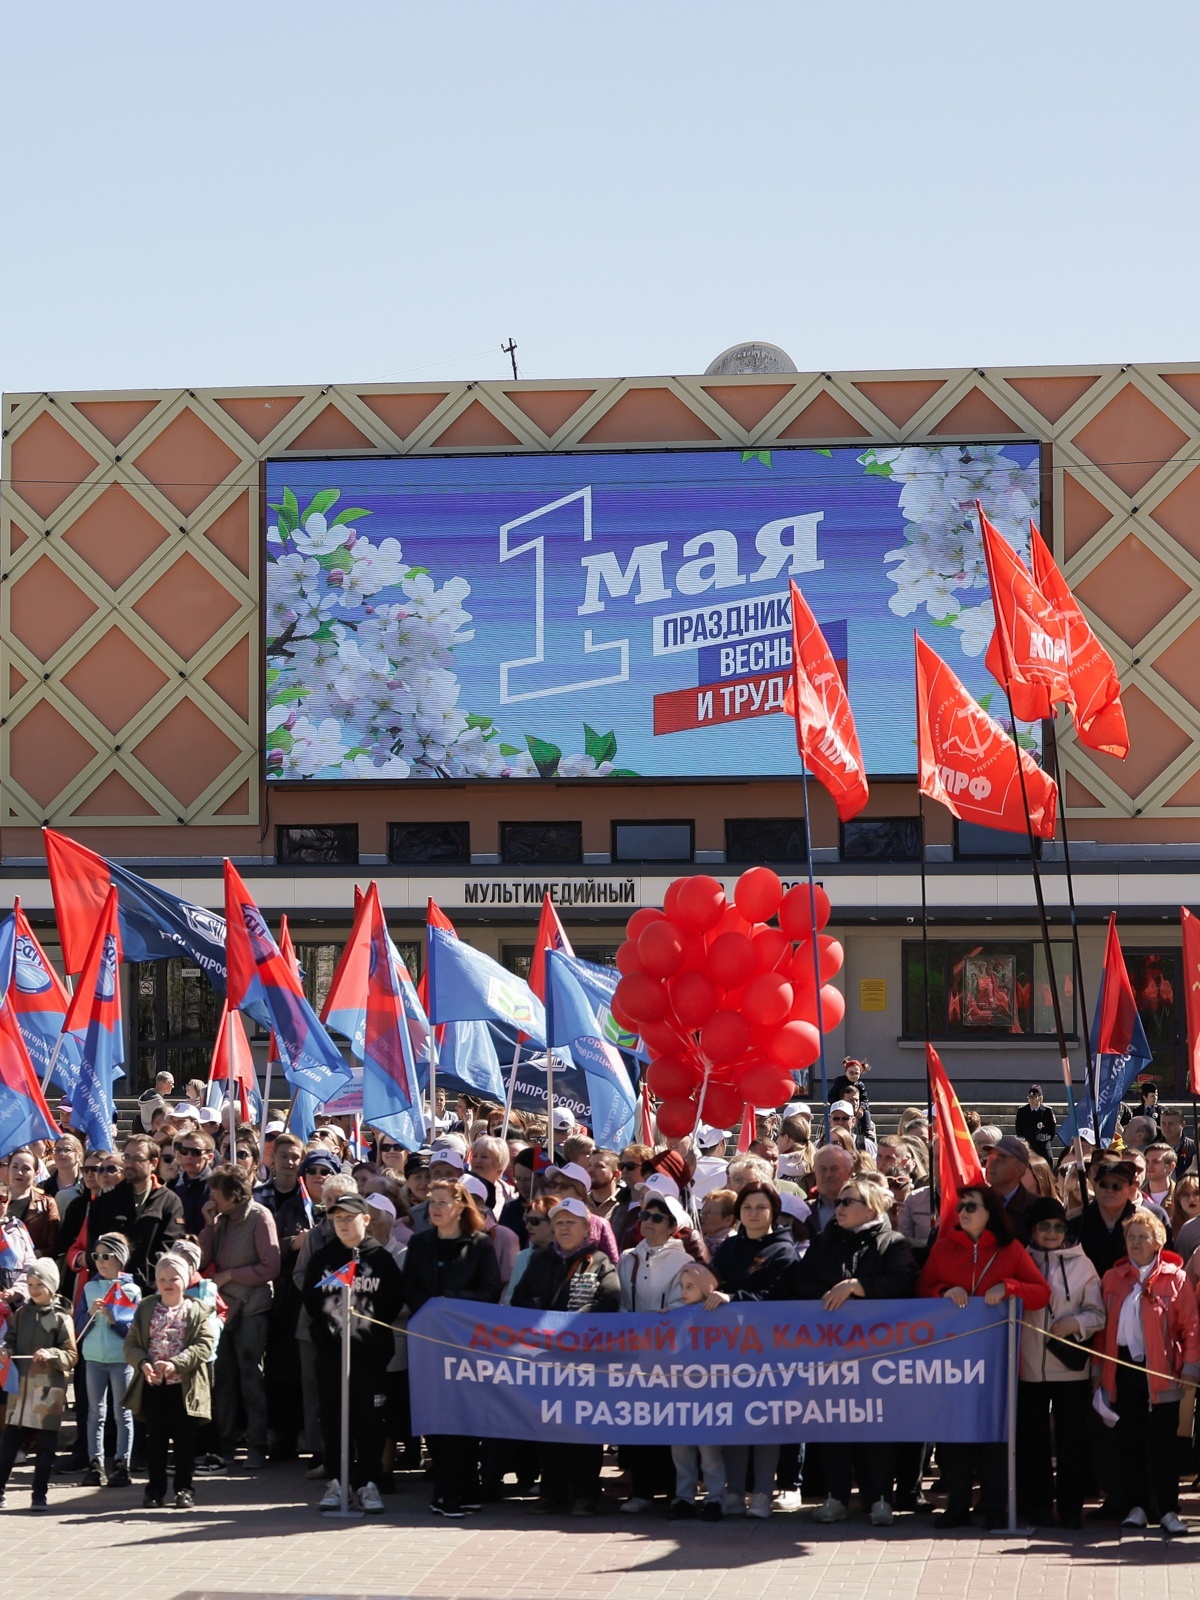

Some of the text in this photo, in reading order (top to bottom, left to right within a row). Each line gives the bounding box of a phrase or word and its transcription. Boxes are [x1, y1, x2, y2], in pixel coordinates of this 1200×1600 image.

[500, 486, 825, 704] 1 мая
[663, 596, 792, 648] ПРАЗДНИК
[1030, 631, 1069, 667] КПР
[697, 693, 712, 721] И
[937, 696, 955, 716] ТРУД
[936, 763, 992, 801] ПРФ
[464, 879, 636, 906] МУЛЬТИМЕДИЙНЫЙ
[469, 1320, 676, 1353] ДОСТОЙНЫЙ
[688, 1325, 764, 1354] ТРУД
[773, 1320, 935, 1351] КАЖДОГО
[443, 1357, 986, 1389] ГАРАНТИЯ БЛАГОПОЛУЧИЯ СЕМЬИ
[541, 1398, 884, 1427] И РАЗВИТИЯ СТРАНЫ!
